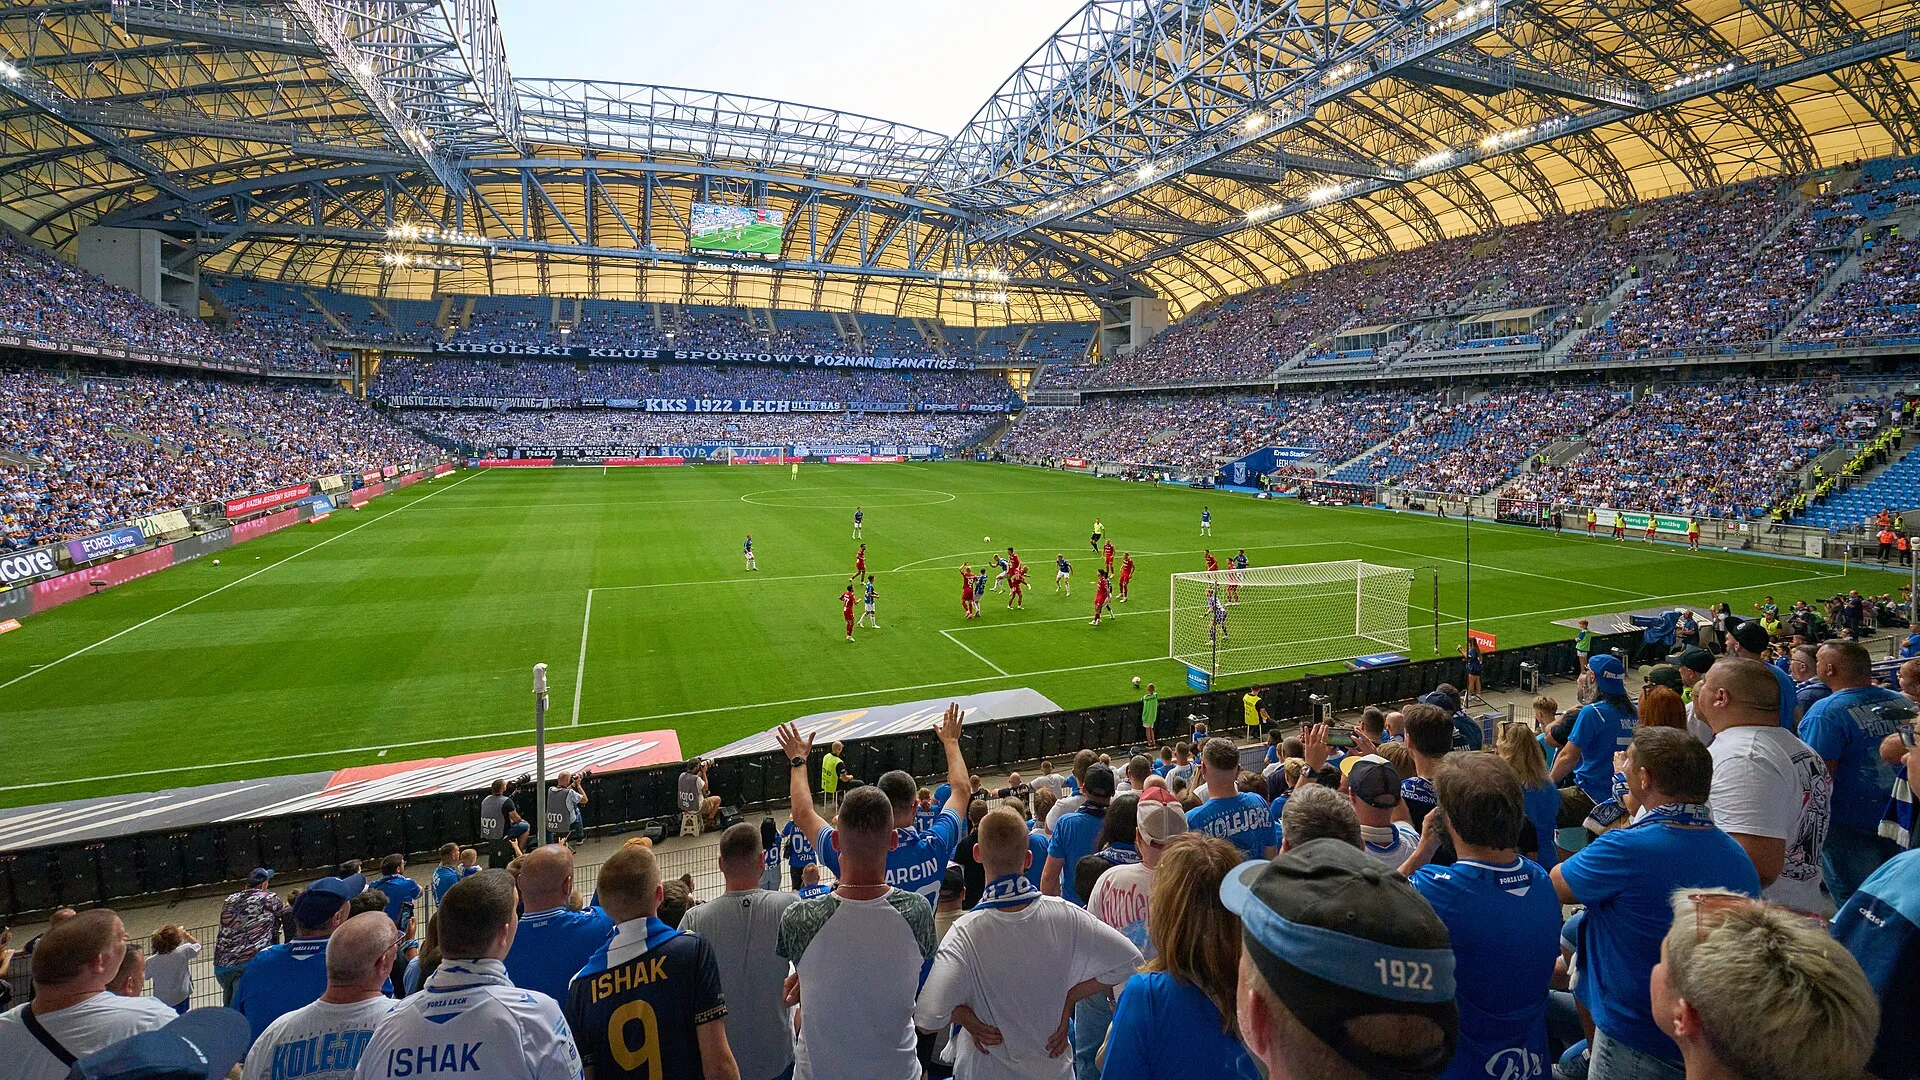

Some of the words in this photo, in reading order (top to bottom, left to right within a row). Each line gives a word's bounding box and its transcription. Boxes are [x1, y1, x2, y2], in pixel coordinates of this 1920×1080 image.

[697, 260, 728, 271] Enea
[731, 263, 773, 273] Stadion
[435, 342, 572, 356] KIBOLSKI
[588, 348, 658, 358] KLUB
[674, 350, 811, 363] SPORTOWY
[891, 357, 957, 370] FANATICS
[391, 395, 424, 406] MIASTO
[645, 398, 687, 412] KKS
[694, 399, 733, 412] 1922
[739, 400, 791, 413] LECH
[82, 534, 114, 552] iFOREX
[118, 535, 134, 544] Europe
[1475, 637, 1495, 648] TIHL
[680, 791, 694, 802] OTO
[547, 812, 563, 823] OTO
[884, 857, 938, 885] ARCIN
[804, 888, 822, 897] LEON
[591, 955, 668, 1004] ISHAK
[1374, 958, 1434, 991] 1922
[426, 1000, 447, 1009] FORZA
[448, 997, 468, 1006] LECH
[608, 999, 663, 1080] 9
[271, 1030, 375, 1080] KOLEJO
[387, 1041, 484, 1078] ISHAK
